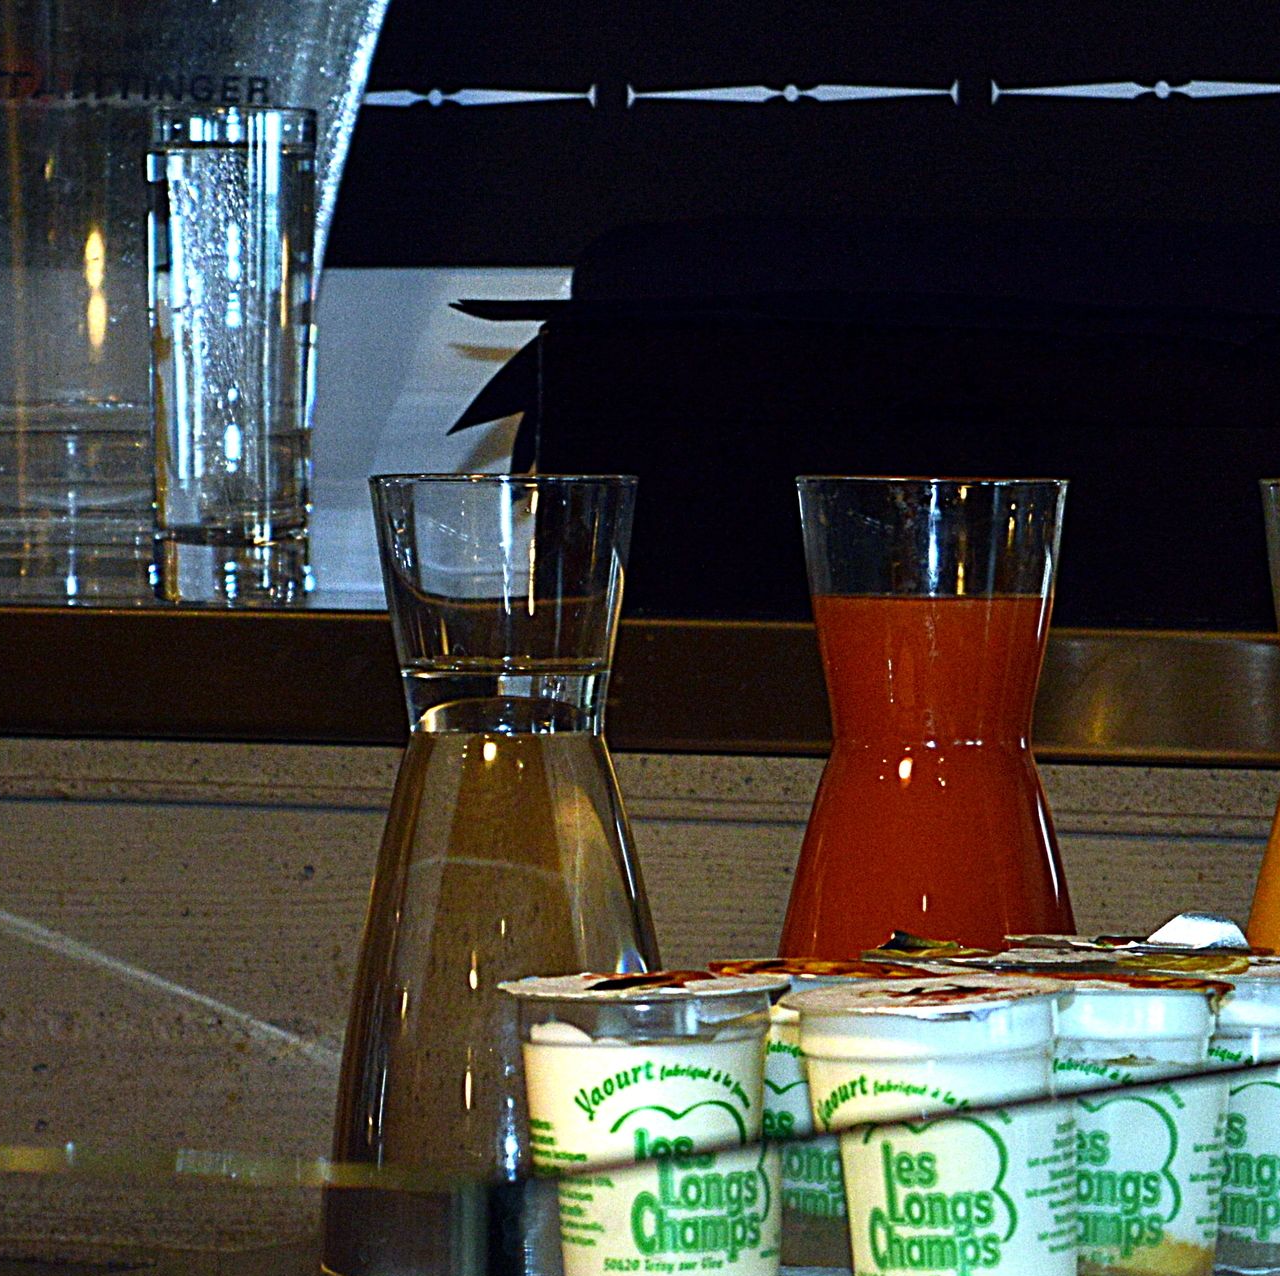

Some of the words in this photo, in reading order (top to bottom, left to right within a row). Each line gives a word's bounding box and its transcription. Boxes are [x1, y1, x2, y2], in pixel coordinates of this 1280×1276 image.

[574, 1061, 654, 1122] Yaourt
[762, 1109, 795, 1139] es
[1076, 1128, 1110, 1167] es
[658, 1170, 757, 1217] Longs
[889, 1190, 995, 1237] Longs
[1076, 1169, 1162, 1215] ongs
[631, 1191, 761, 1263] Champs
